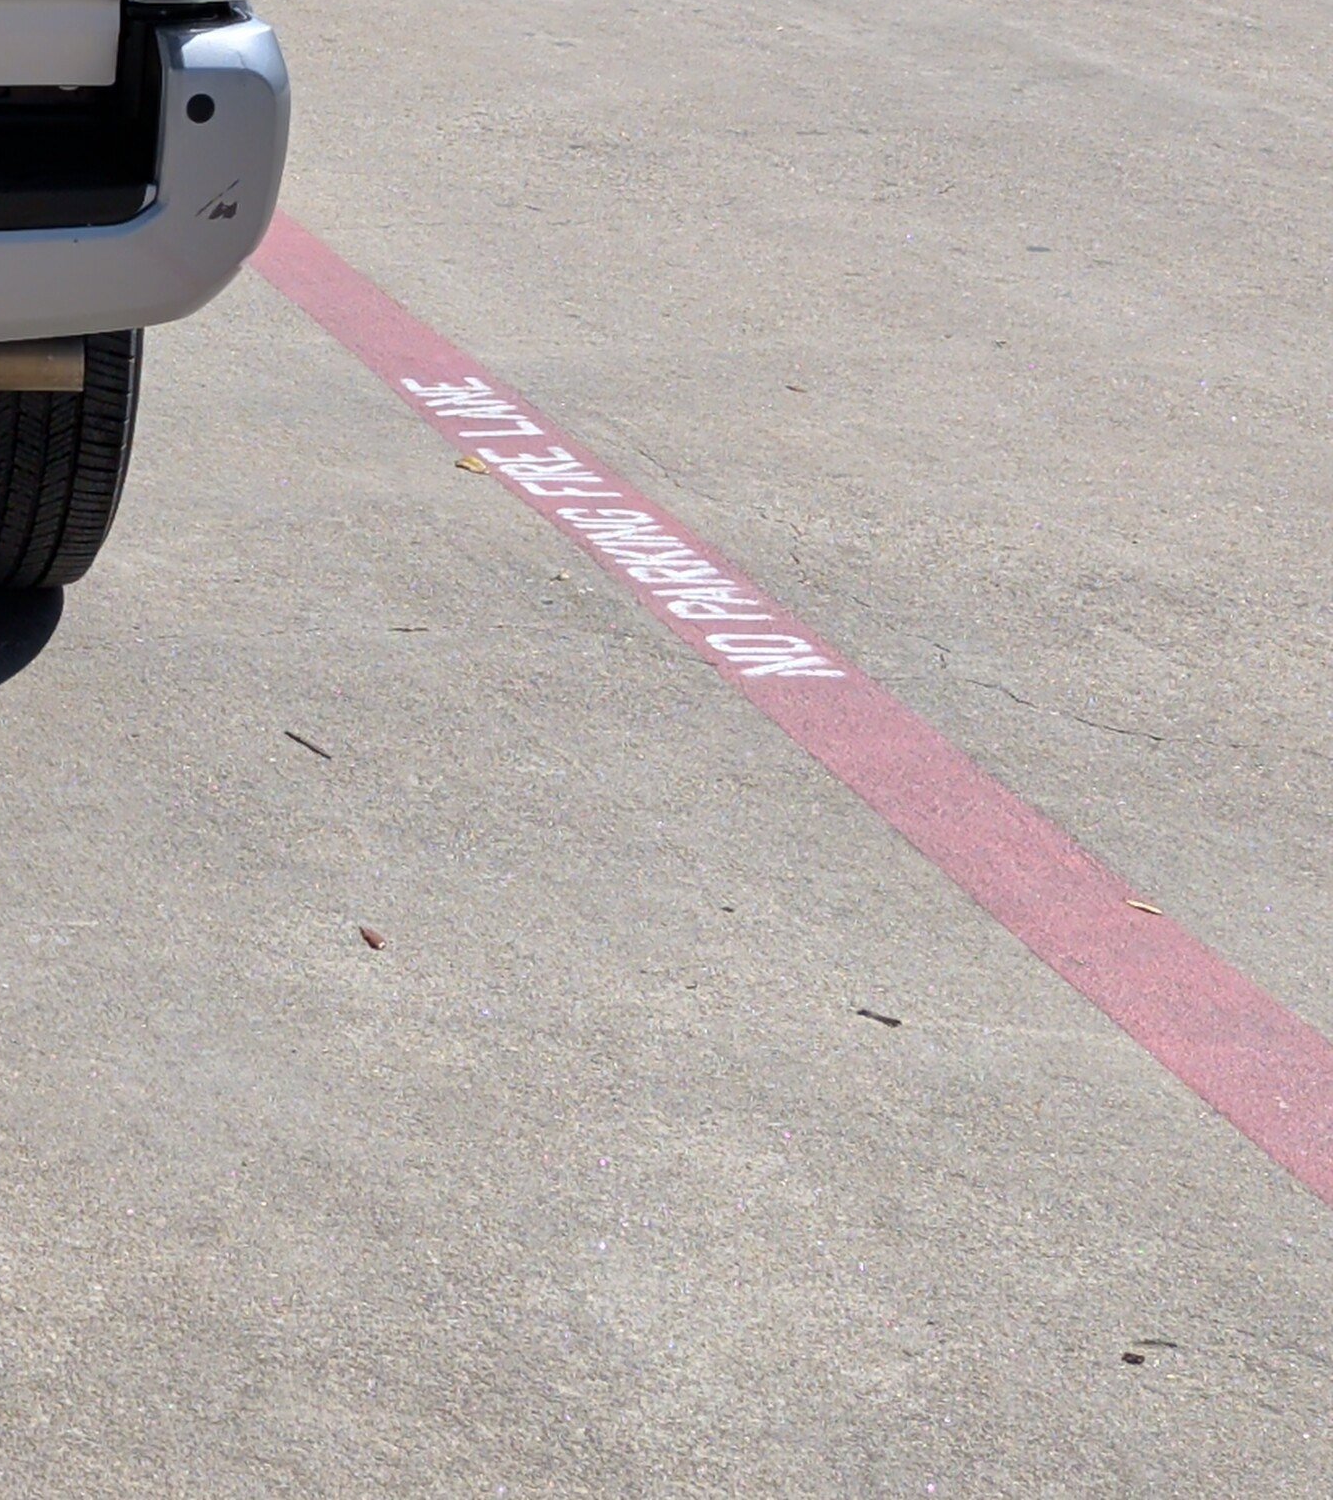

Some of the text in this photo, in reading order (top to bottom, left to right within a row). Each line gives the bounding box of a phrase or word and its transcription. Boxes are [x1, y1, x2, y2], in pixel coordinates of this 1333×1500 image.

[400, 375, 846, 678] NO PARKING FIRE LANE
